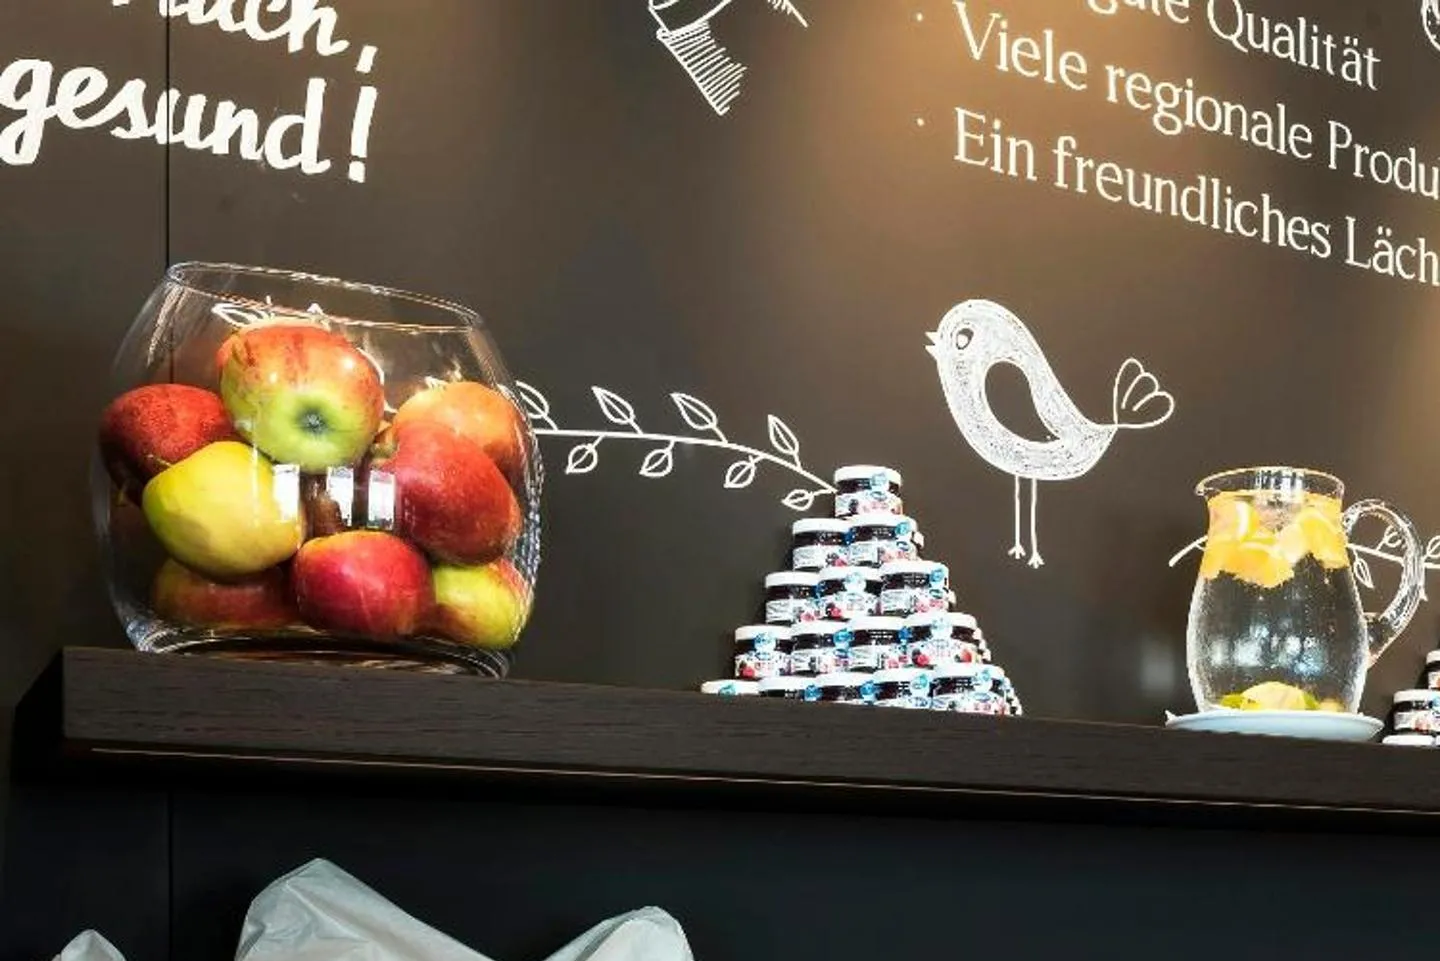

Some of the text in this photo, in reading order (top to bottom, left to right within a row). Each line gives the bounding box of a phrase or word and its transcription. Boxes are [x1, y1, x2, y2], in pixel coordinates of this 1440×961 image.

[955, 0, 1088, 91] Viele
[1105, 63, 1313, 160] regionale
[1207, 0, 1382, 92] Qualität
[954, 107, 1037, 182] Ein
[1053, 136, 1332, 258] freundliches
